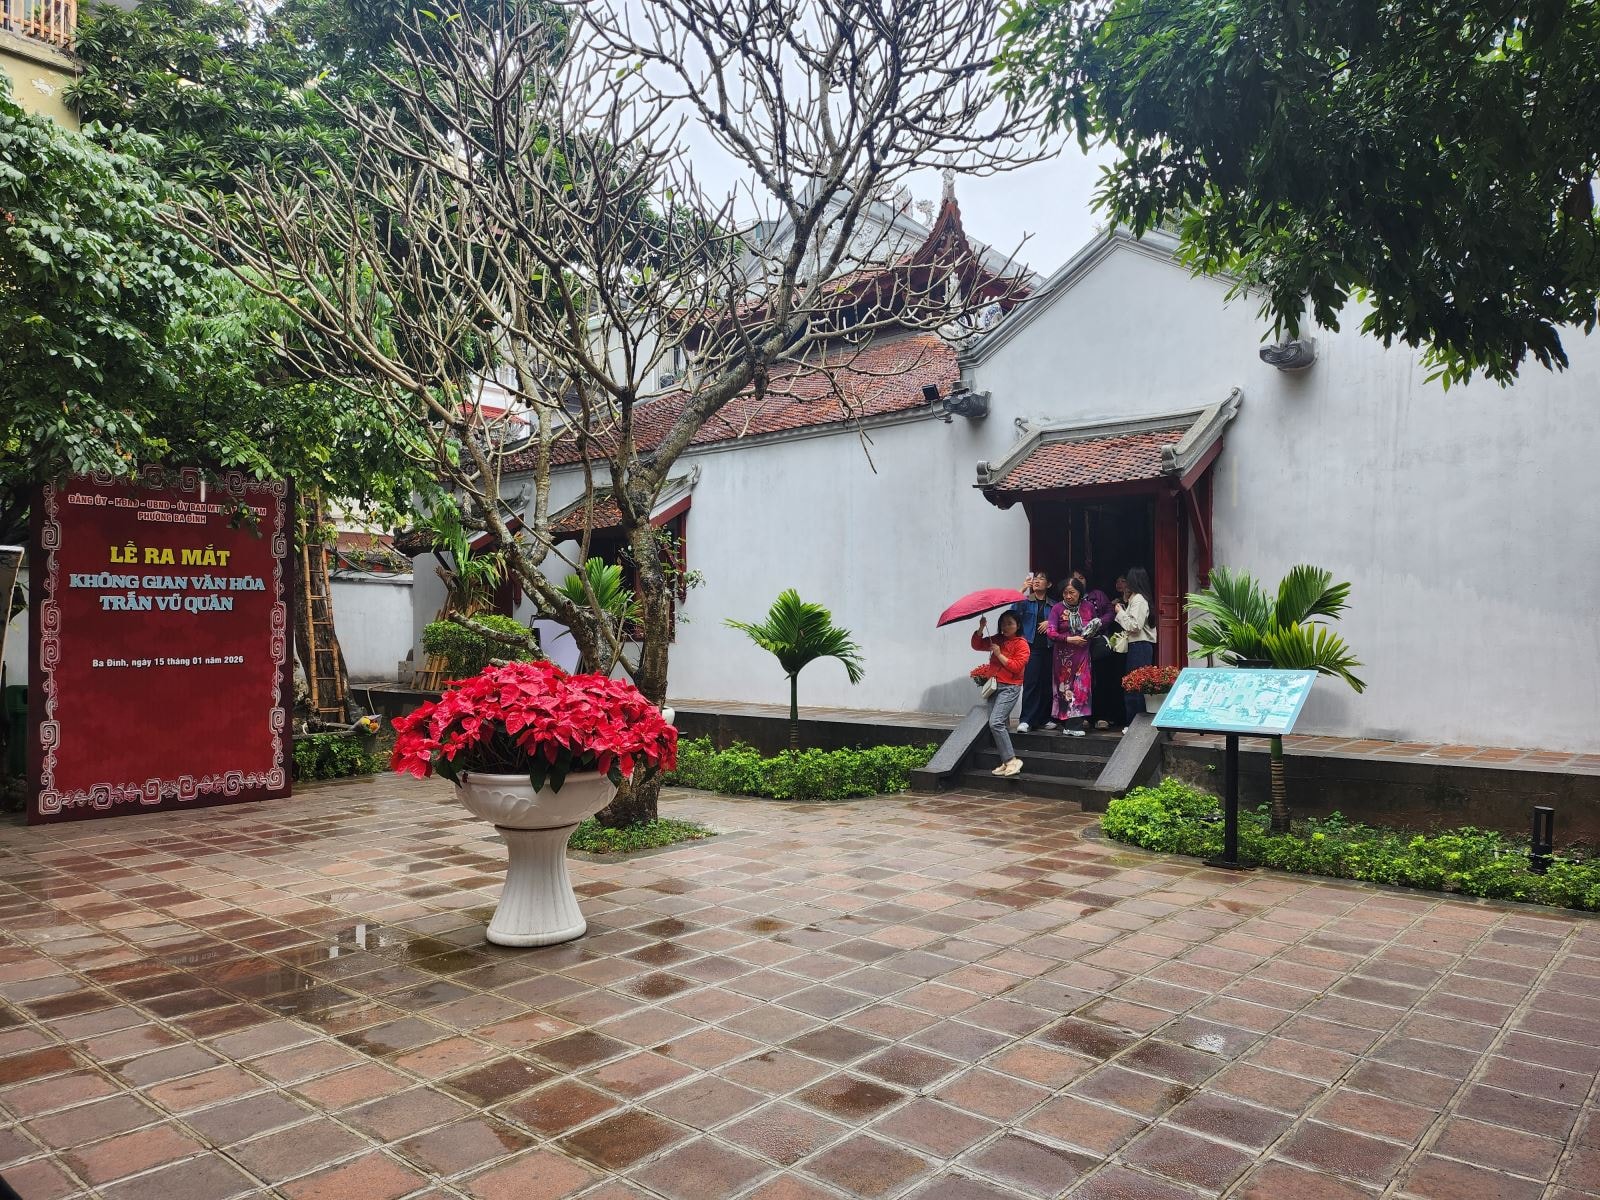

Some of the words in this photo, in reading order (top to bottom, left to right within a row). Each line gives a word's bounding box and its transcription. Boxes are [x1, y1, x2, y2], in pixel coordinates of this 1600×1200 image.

[146, 500, 170, 510] UBND
[189, 503, 207, 512] BAN
[173, 513, 186, 523] BA
[110, 540, 138, 564] LỄ
[144, 547, 175, 565] RA
[181, 544, 231, 566] MẮT
[69, 571, 140, 589] KHÔNG
[142, 575, 188, 590] GIAN
[190, 574, 227, 590] VĂN
[229, 575, 266, 591] HÓA
[155, 593, 182, 611] VŨ
[184, 594, 234, 614] QUÁN
[92, 659, 104, 667] Ba
[154, 657, 165, 666] 15
[167, 657, 190, 666] tháng
[192, 656, 202, 665] 01
[224, 655, 244, 664] 2026
